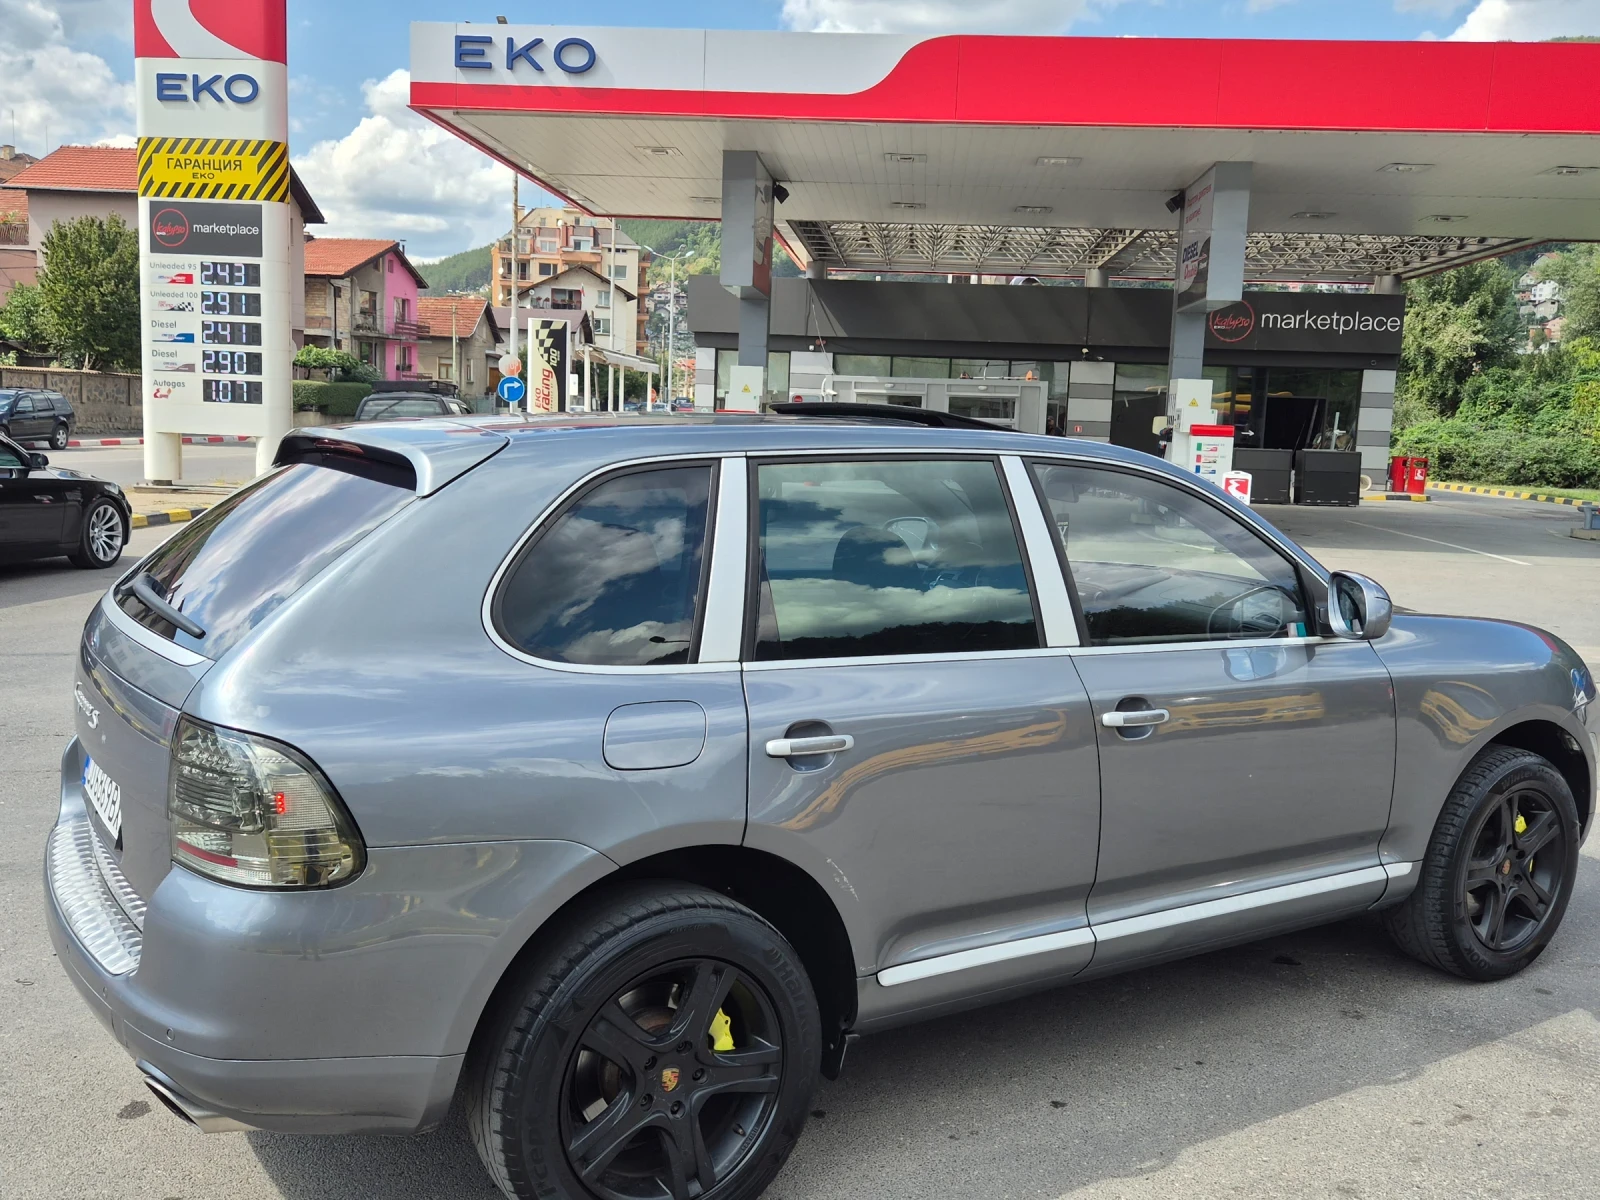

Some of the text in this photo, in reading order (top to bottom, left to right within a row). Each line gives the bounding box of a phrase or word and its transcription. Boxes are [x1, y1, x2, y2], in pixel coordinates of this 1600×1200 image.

[455, 35, 596, 74] EKO
[156, 73, 259, 104] EKO
[167, 158, 242, 173] ГАРАНЦИЯ
[193, 223, 260, 236] marketplace
[149, 262, 185, 270] Unleaded
[151, 320, 177, 328] Diesel
[1213, 313, 1250, 330] kalypso
[1261, 310, 1401, 335] marketplace
[151, 349, 178, 358] Diesel
[549, 348, 557, 366] 100
[153, 379, 186, 389] Autogas
[542, 368, 554, 412] racing
